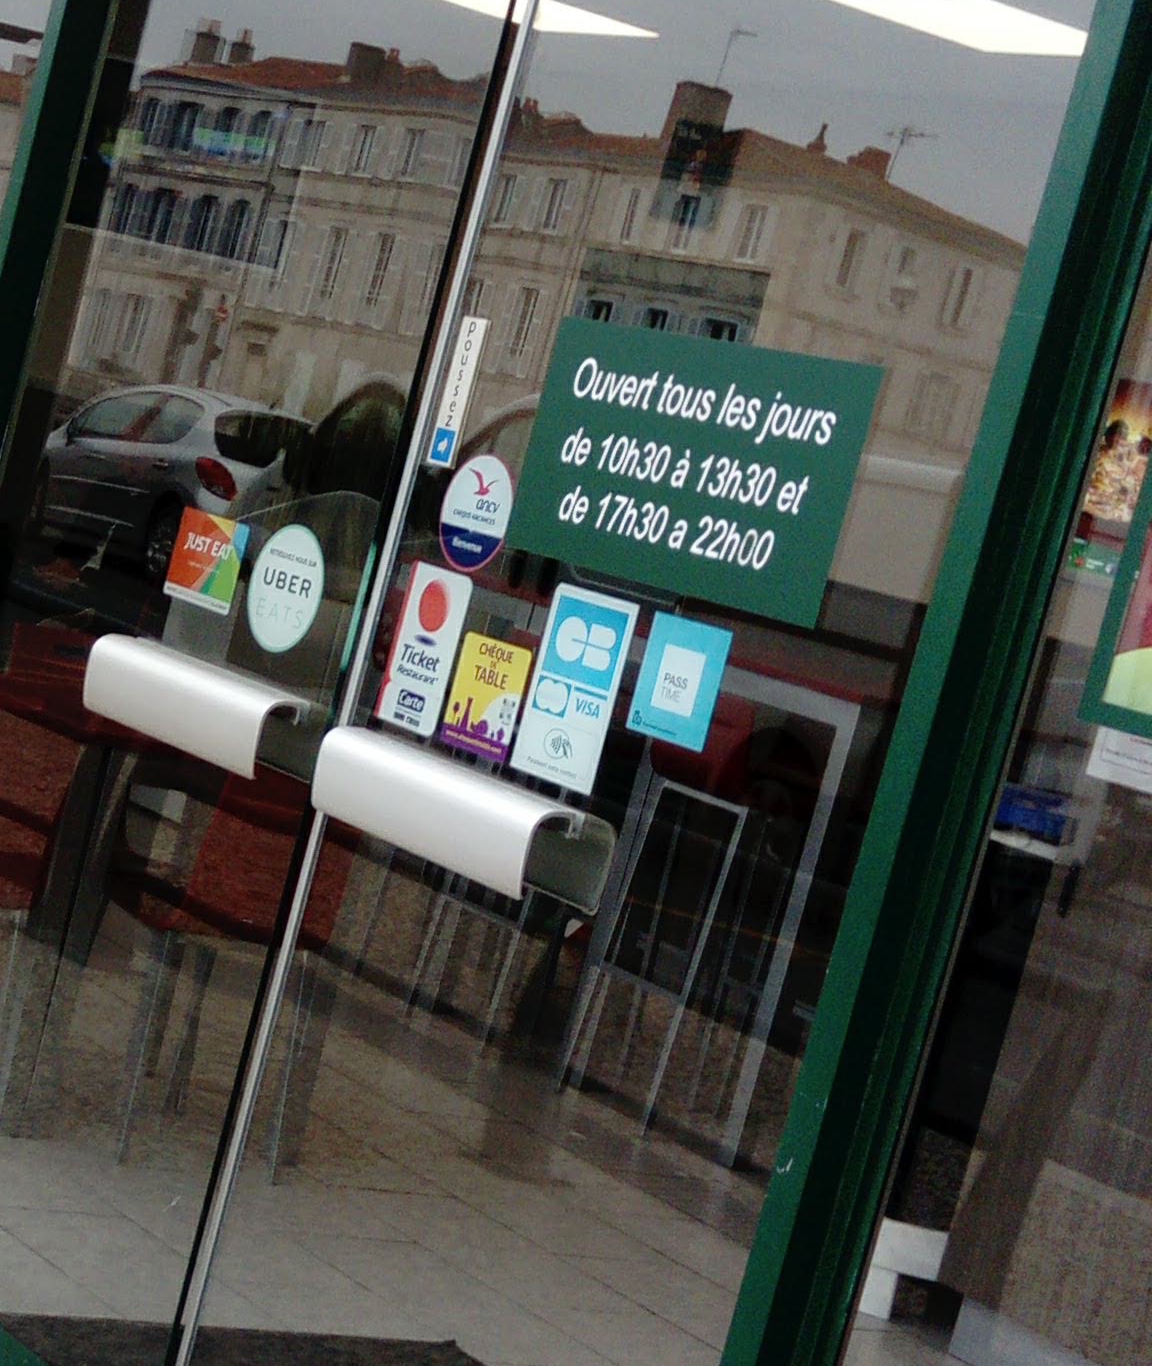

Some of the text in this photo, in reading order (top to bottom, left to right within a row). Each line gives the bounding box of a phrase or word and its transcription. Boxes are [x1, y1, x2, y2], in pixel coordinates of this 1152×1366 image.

[573, 357, 837, 446] Ouvert tous les jours
[561, 427, 809, 515] de 10h30 à 13h30 et
[558, 485, 775, 570] de 17h30 a 22h00
[184, 532, 234, 560] JUST EAT
[263, 567, 312, 598] UBER
[255, 597, 304, 629] EATS
[401, 643, 440, 672] Ticket
[474, 664, 508, 690] TABLE
[663, 672, 688, 690] PASS
[575, 698, 600, 719] VISA
[660, 686, 682, 703] TIME
